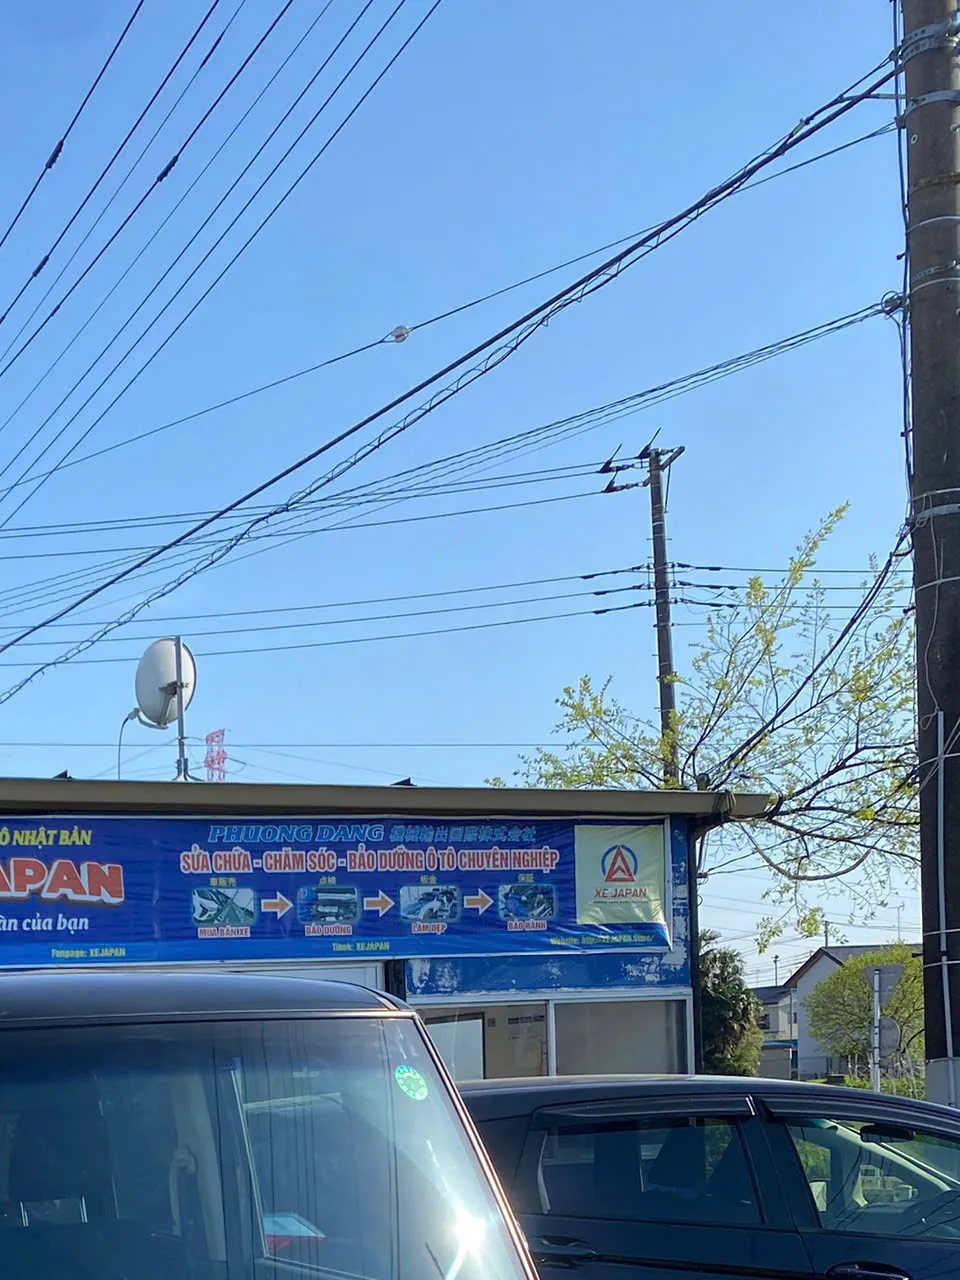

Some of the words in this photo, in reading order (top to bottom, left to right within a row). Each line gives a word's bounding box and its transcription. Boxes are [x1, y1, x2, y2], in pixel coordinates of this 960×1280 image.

[12, 826, 57, 850] NHẬT
[58, 825, 92, 846] BẢN
[208, 825, 312, 843] PHUONG
[315, 824, 385, 842] DANG
[180, 843, 212, 874] SỬA
[212, 846, 253, 874] CHỮA
[263, 847, 306, 873] CHĂM
[307, 847, 336, 872] SÓC
[347, 843, 377, 872] BẢO
[377, 845, 425, 872] DƯỠNG
[426, 846, 437, 871] Ô
[438, 846, 456, 871] TÔ
[458, 846, 510, 871] CHUYÊN
[511, 846, 559, 873] NGHIỆP
[594, 888, 609, 898] XE
[611, 887, 647, 898] JAPAN
[22, 913, 53, 931] của
[56, 914, 89, 935] bạn
